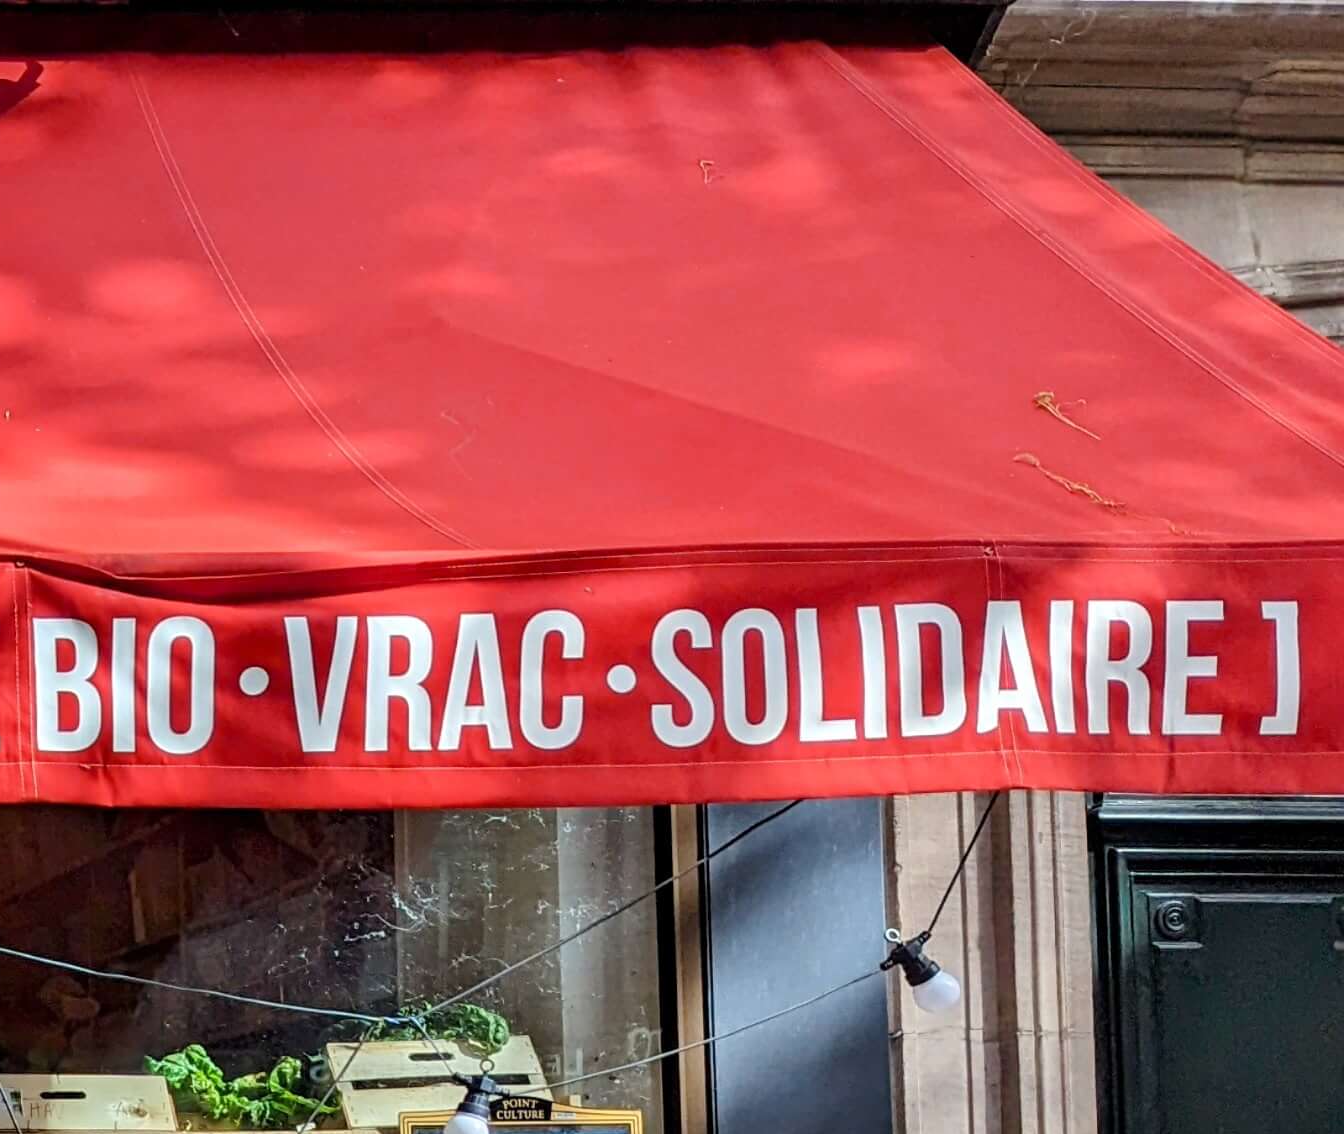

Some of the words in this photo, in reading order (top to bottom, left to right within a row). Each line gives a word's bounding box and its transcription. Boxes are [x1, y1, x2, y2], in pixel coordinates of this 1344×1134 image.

[31, 615, 215, 755] BIO
[282, 608, 583, 752] VRAC
[651, 598, 1224, 749] SOLIDAIRE
[502, 1098, 538, 1110] POINT
[496, 1109, 545, 1120] CULTURE
